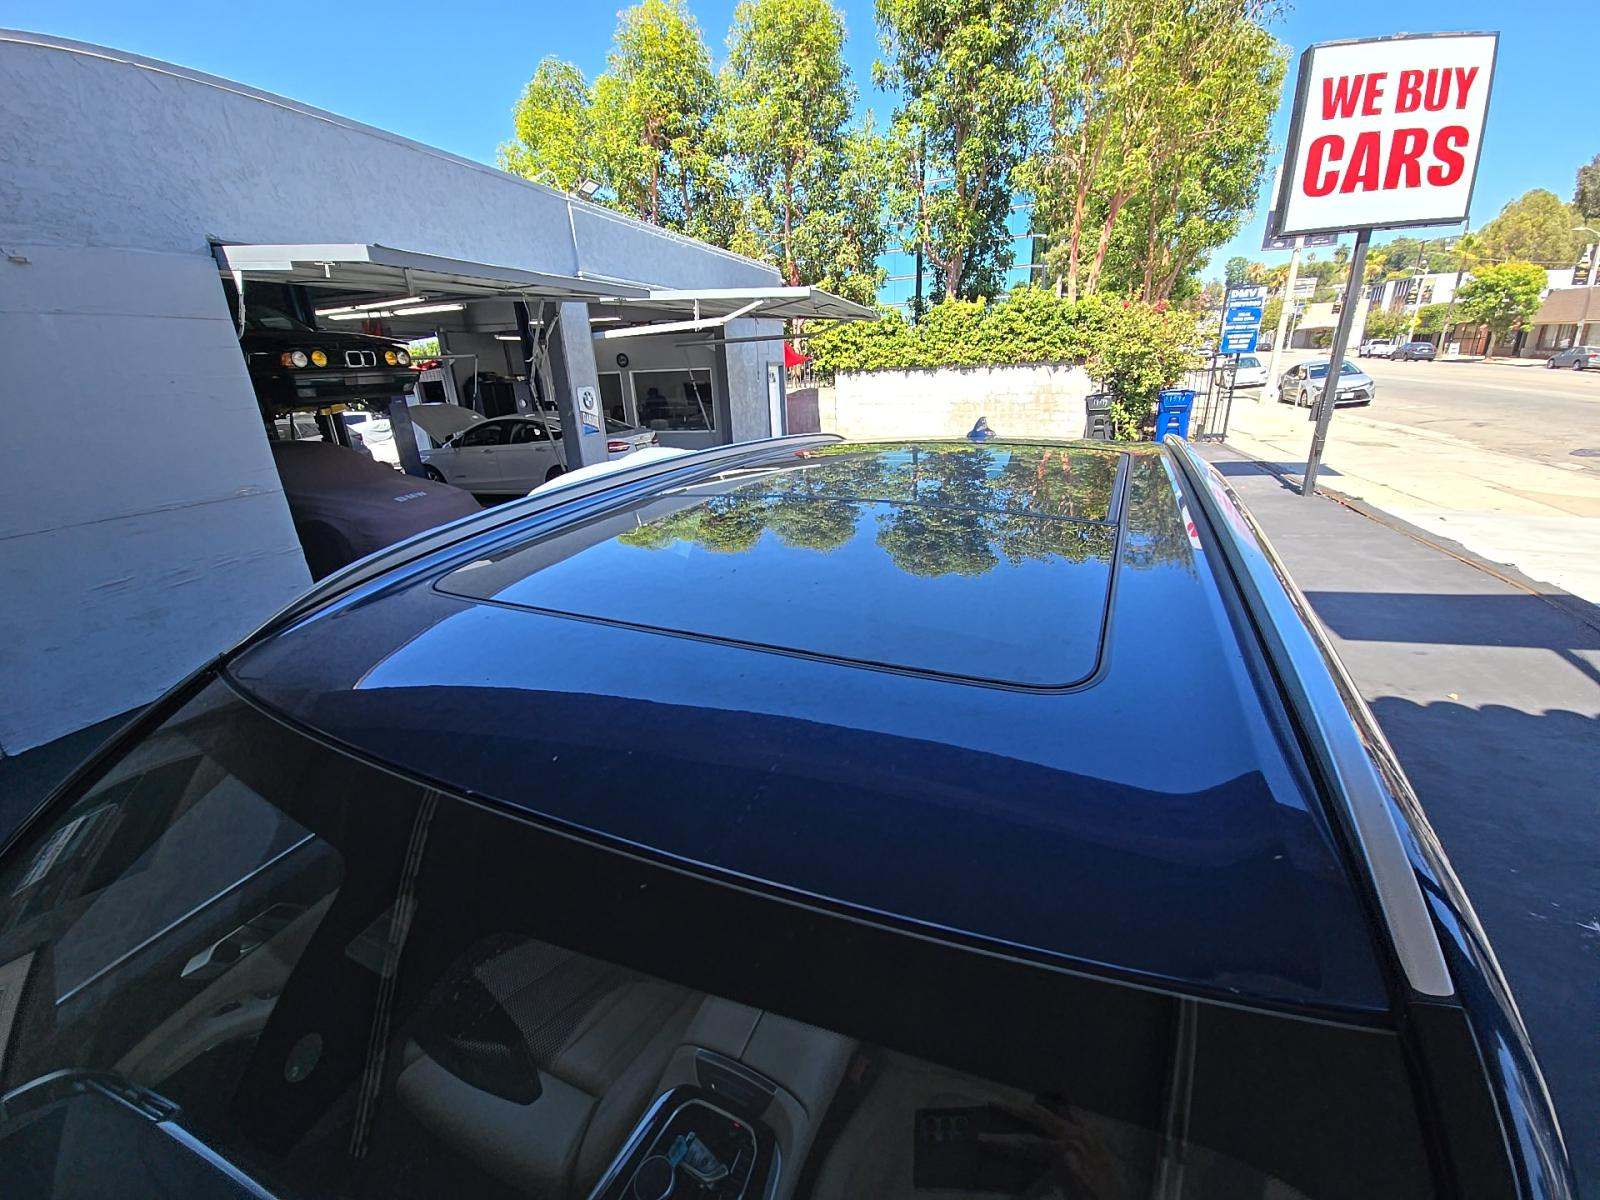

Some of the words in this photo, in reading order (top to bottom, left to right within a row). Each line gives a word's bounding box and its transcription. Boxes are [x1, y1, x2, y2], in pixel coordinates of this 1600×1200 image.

[1322, 72, 1388, 120] WE
[1395, 67, 1479, 113] BUY
[1303, 125, 1470, 197] CARS
[1231, 288, 1258, 298] DMV
[393, 491, 427, 502] BMW
